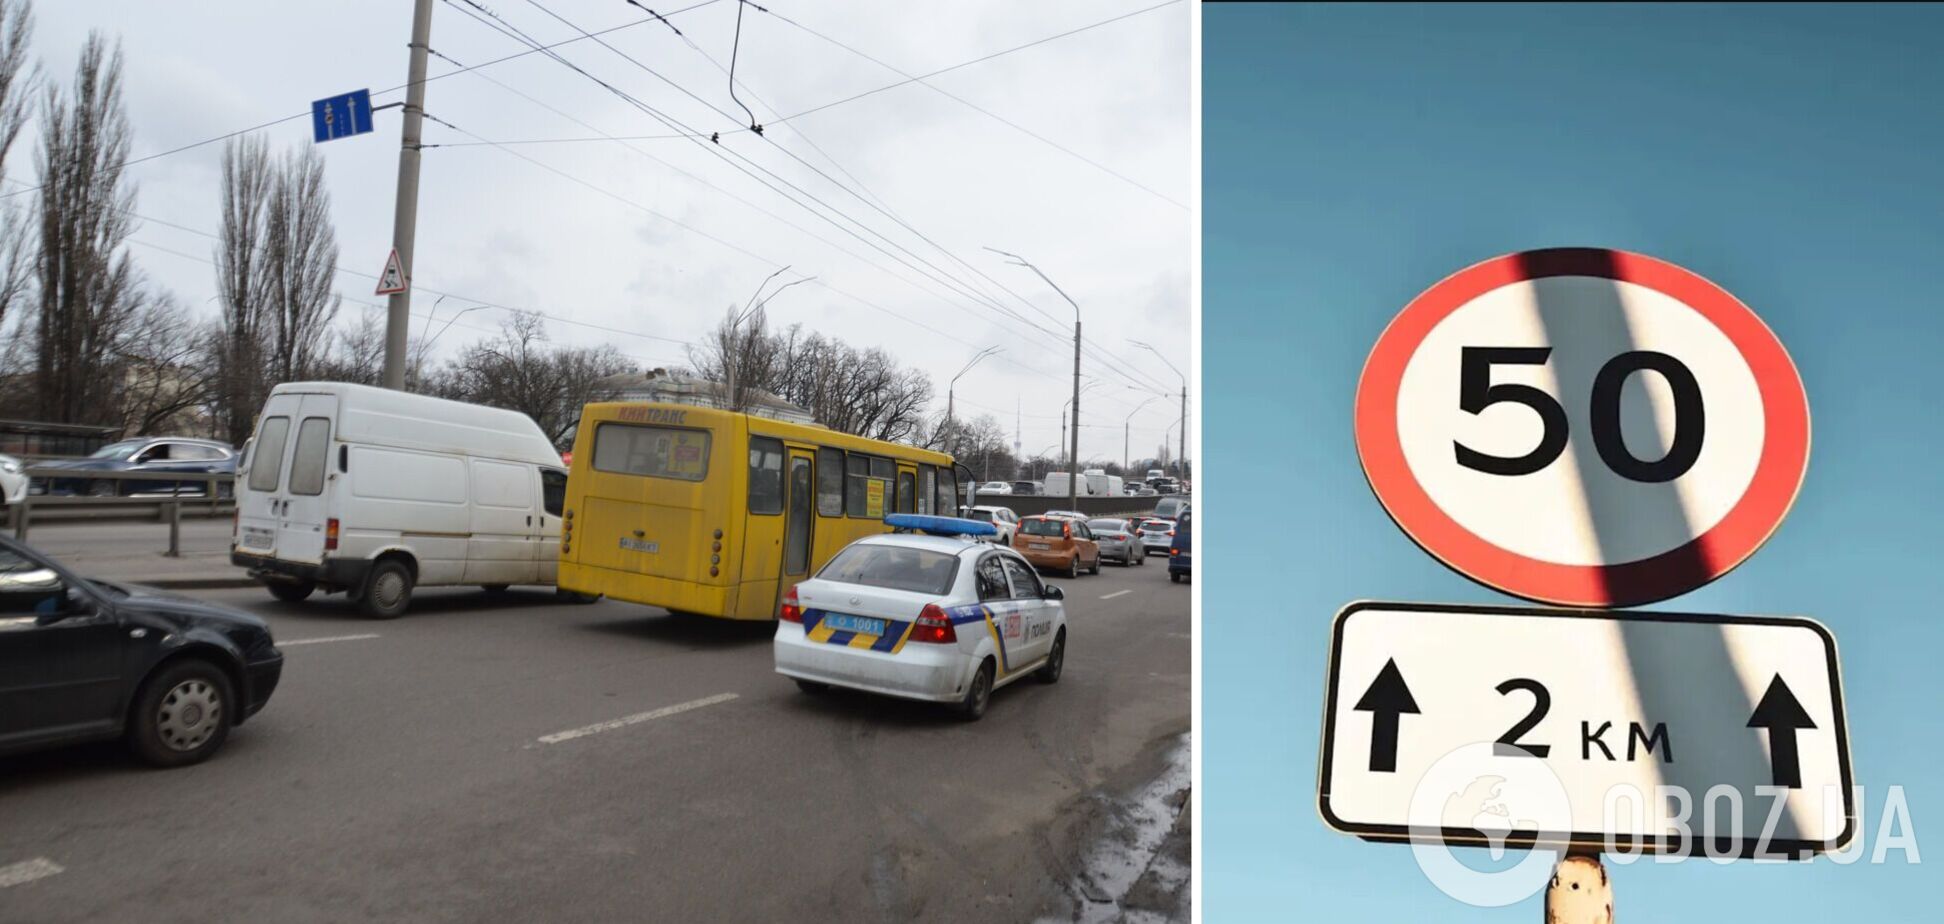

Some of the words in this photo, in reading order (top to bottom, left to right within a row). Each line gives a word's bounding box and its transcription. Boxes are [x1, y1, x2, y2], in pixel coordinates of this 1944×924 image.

[1453, 346, 1706, 483] 50
[853, 616, 879, 631] 1001
[1492, 677, 1552, 759] 2
